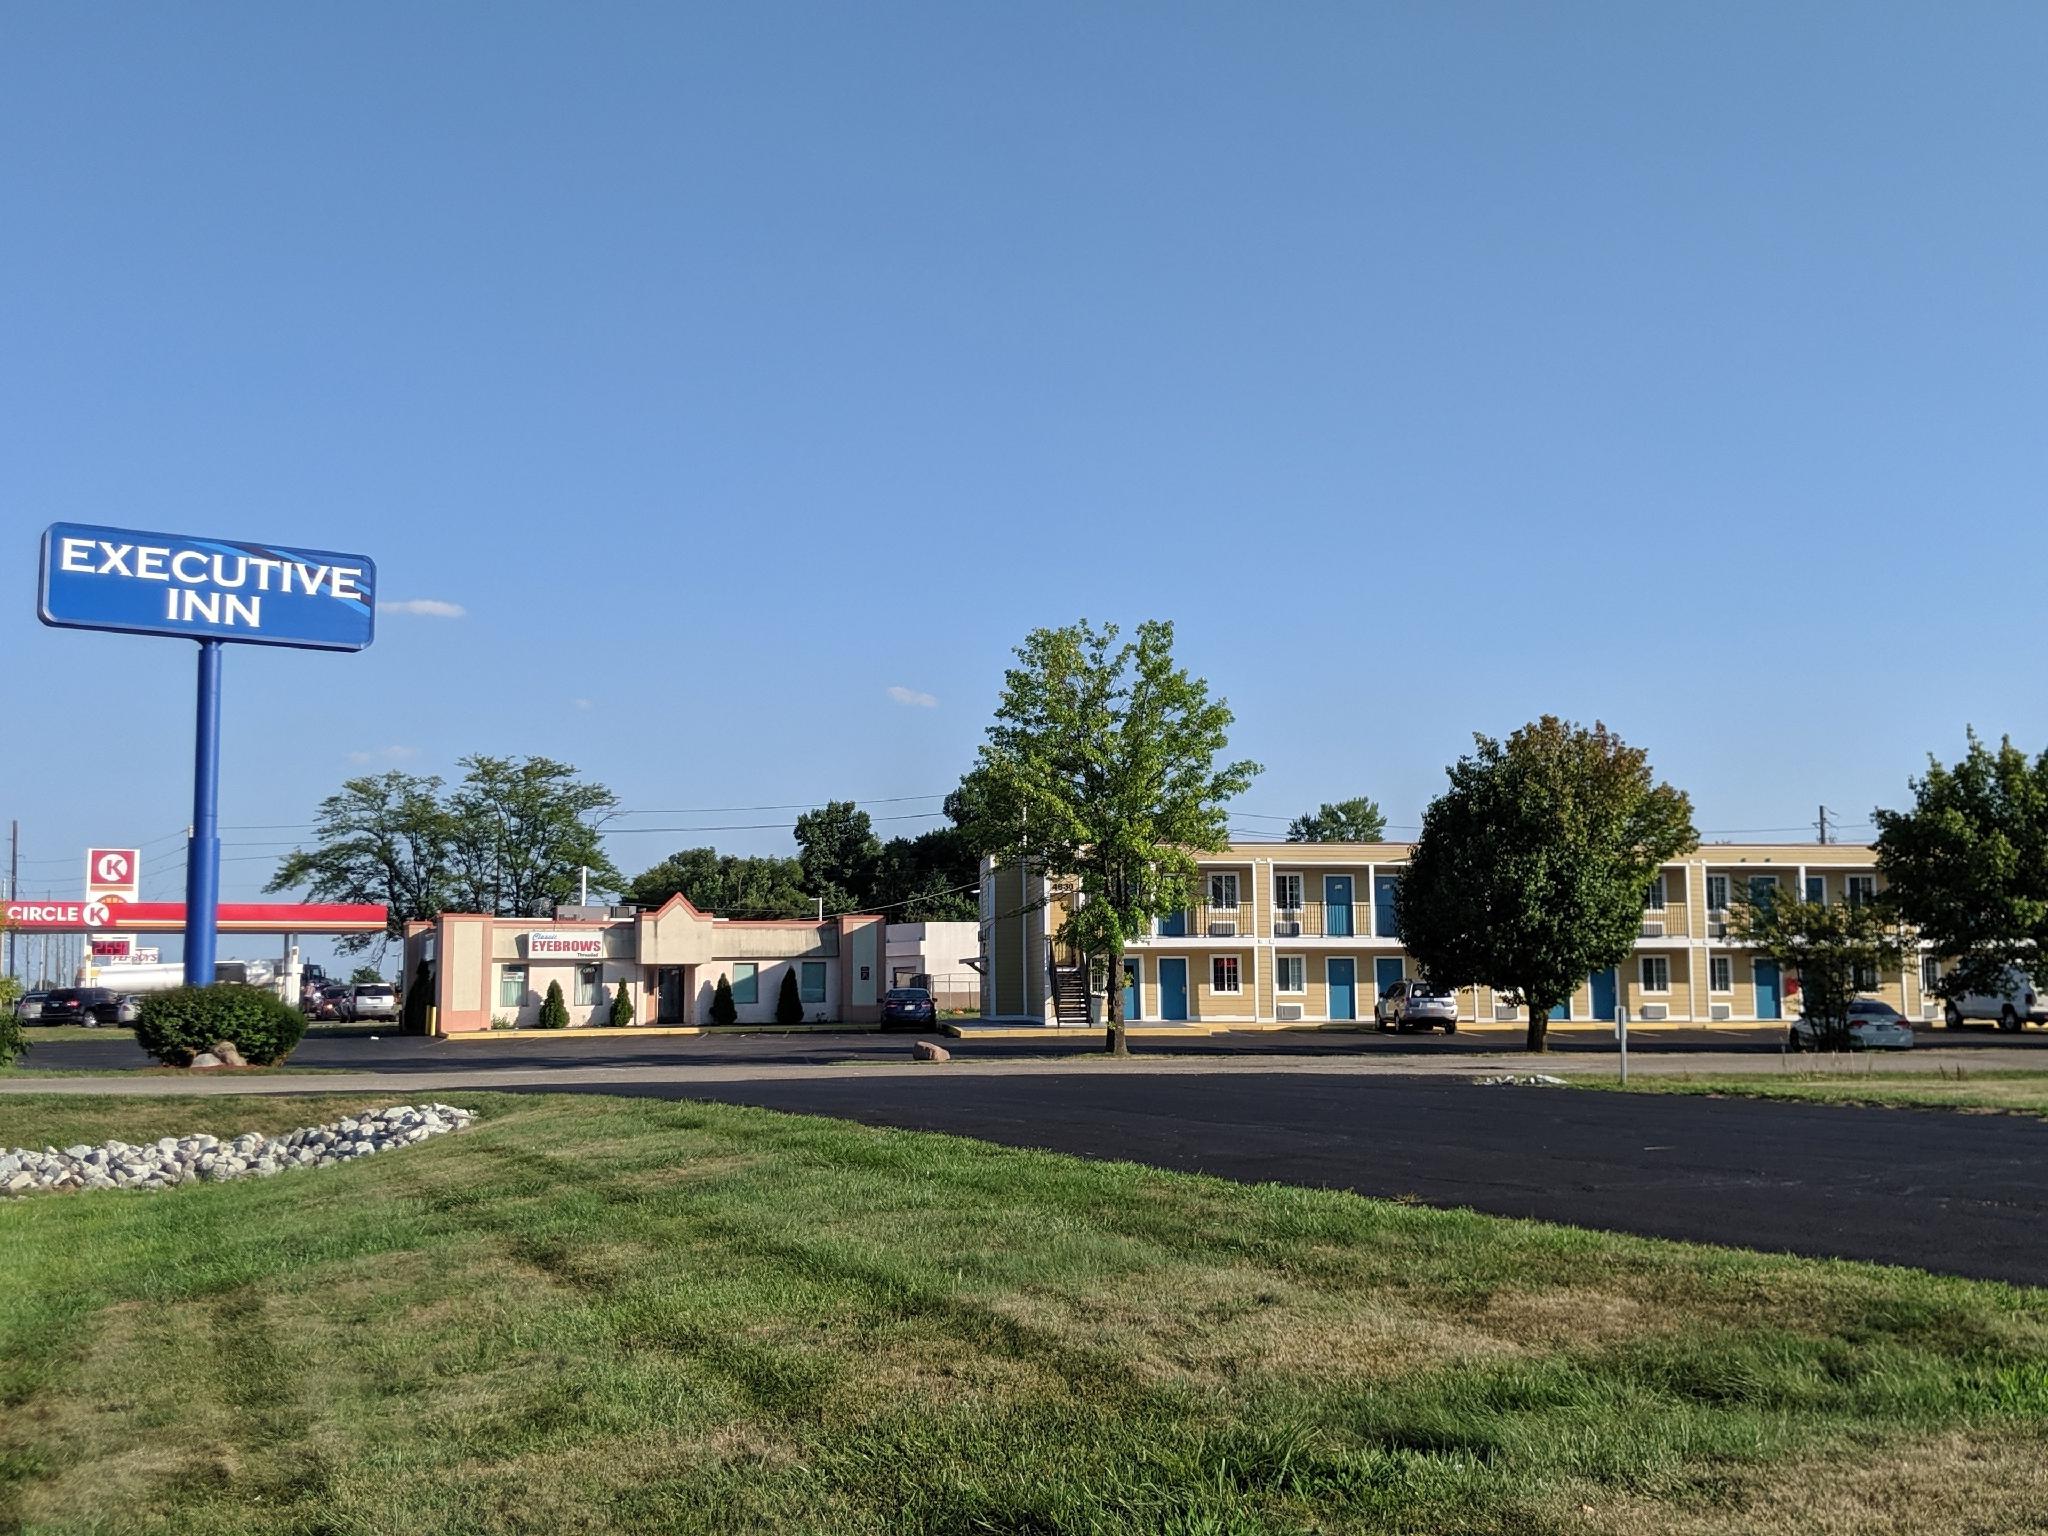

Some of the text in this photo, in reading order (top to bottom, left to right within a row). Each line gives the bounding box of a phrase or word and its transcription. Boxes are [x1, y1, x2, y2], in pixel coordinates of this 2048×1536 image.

[61, 537, 363, 601] EXECUTIVE
[167, 587, 262, 628] INN
[8, 906, 106, 924] CIRCLE K
[532, 941, 601, 951] EYEBROWS
